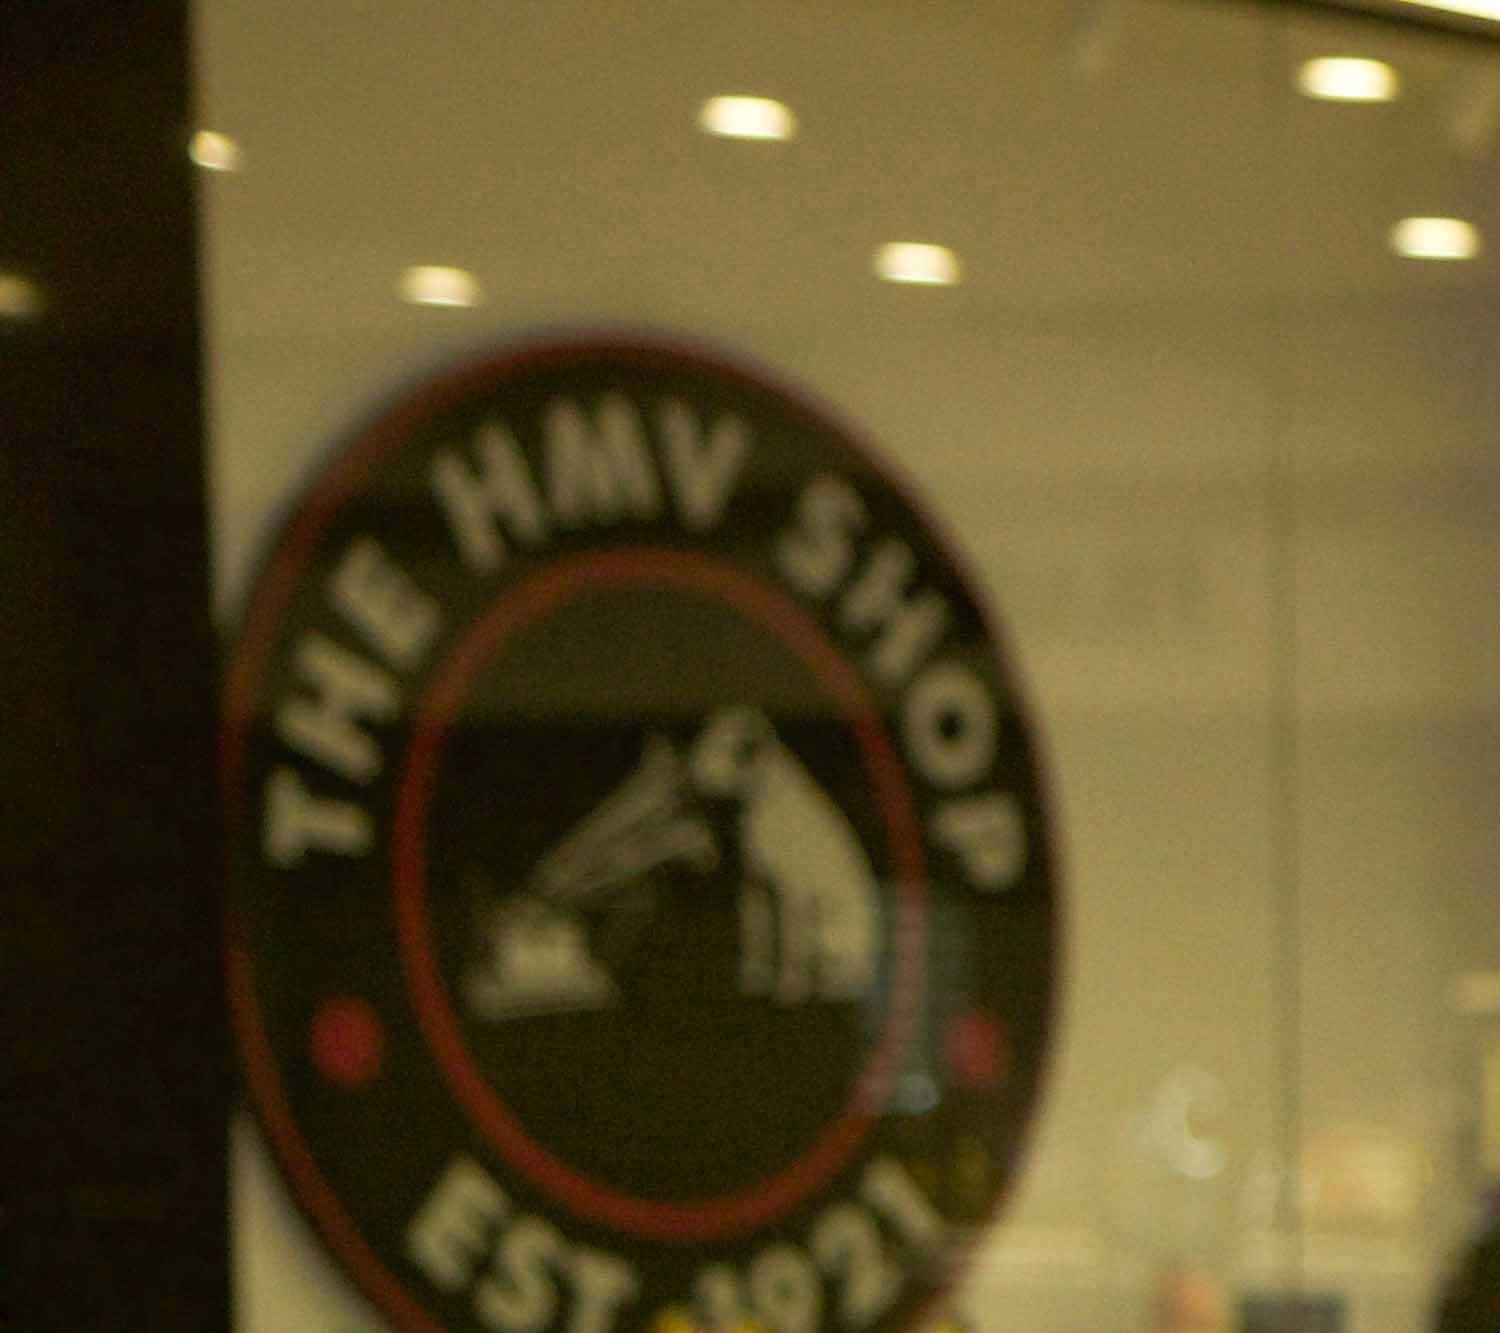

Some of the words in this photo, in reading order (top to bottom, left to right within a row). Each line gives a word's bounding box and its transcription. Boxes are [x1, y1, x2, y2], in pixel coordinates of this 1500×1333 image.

[263, 533, 445, 872] THE
[430, 390, 752, 575] HMV
[778, 475, 1027, 892] SHOP
